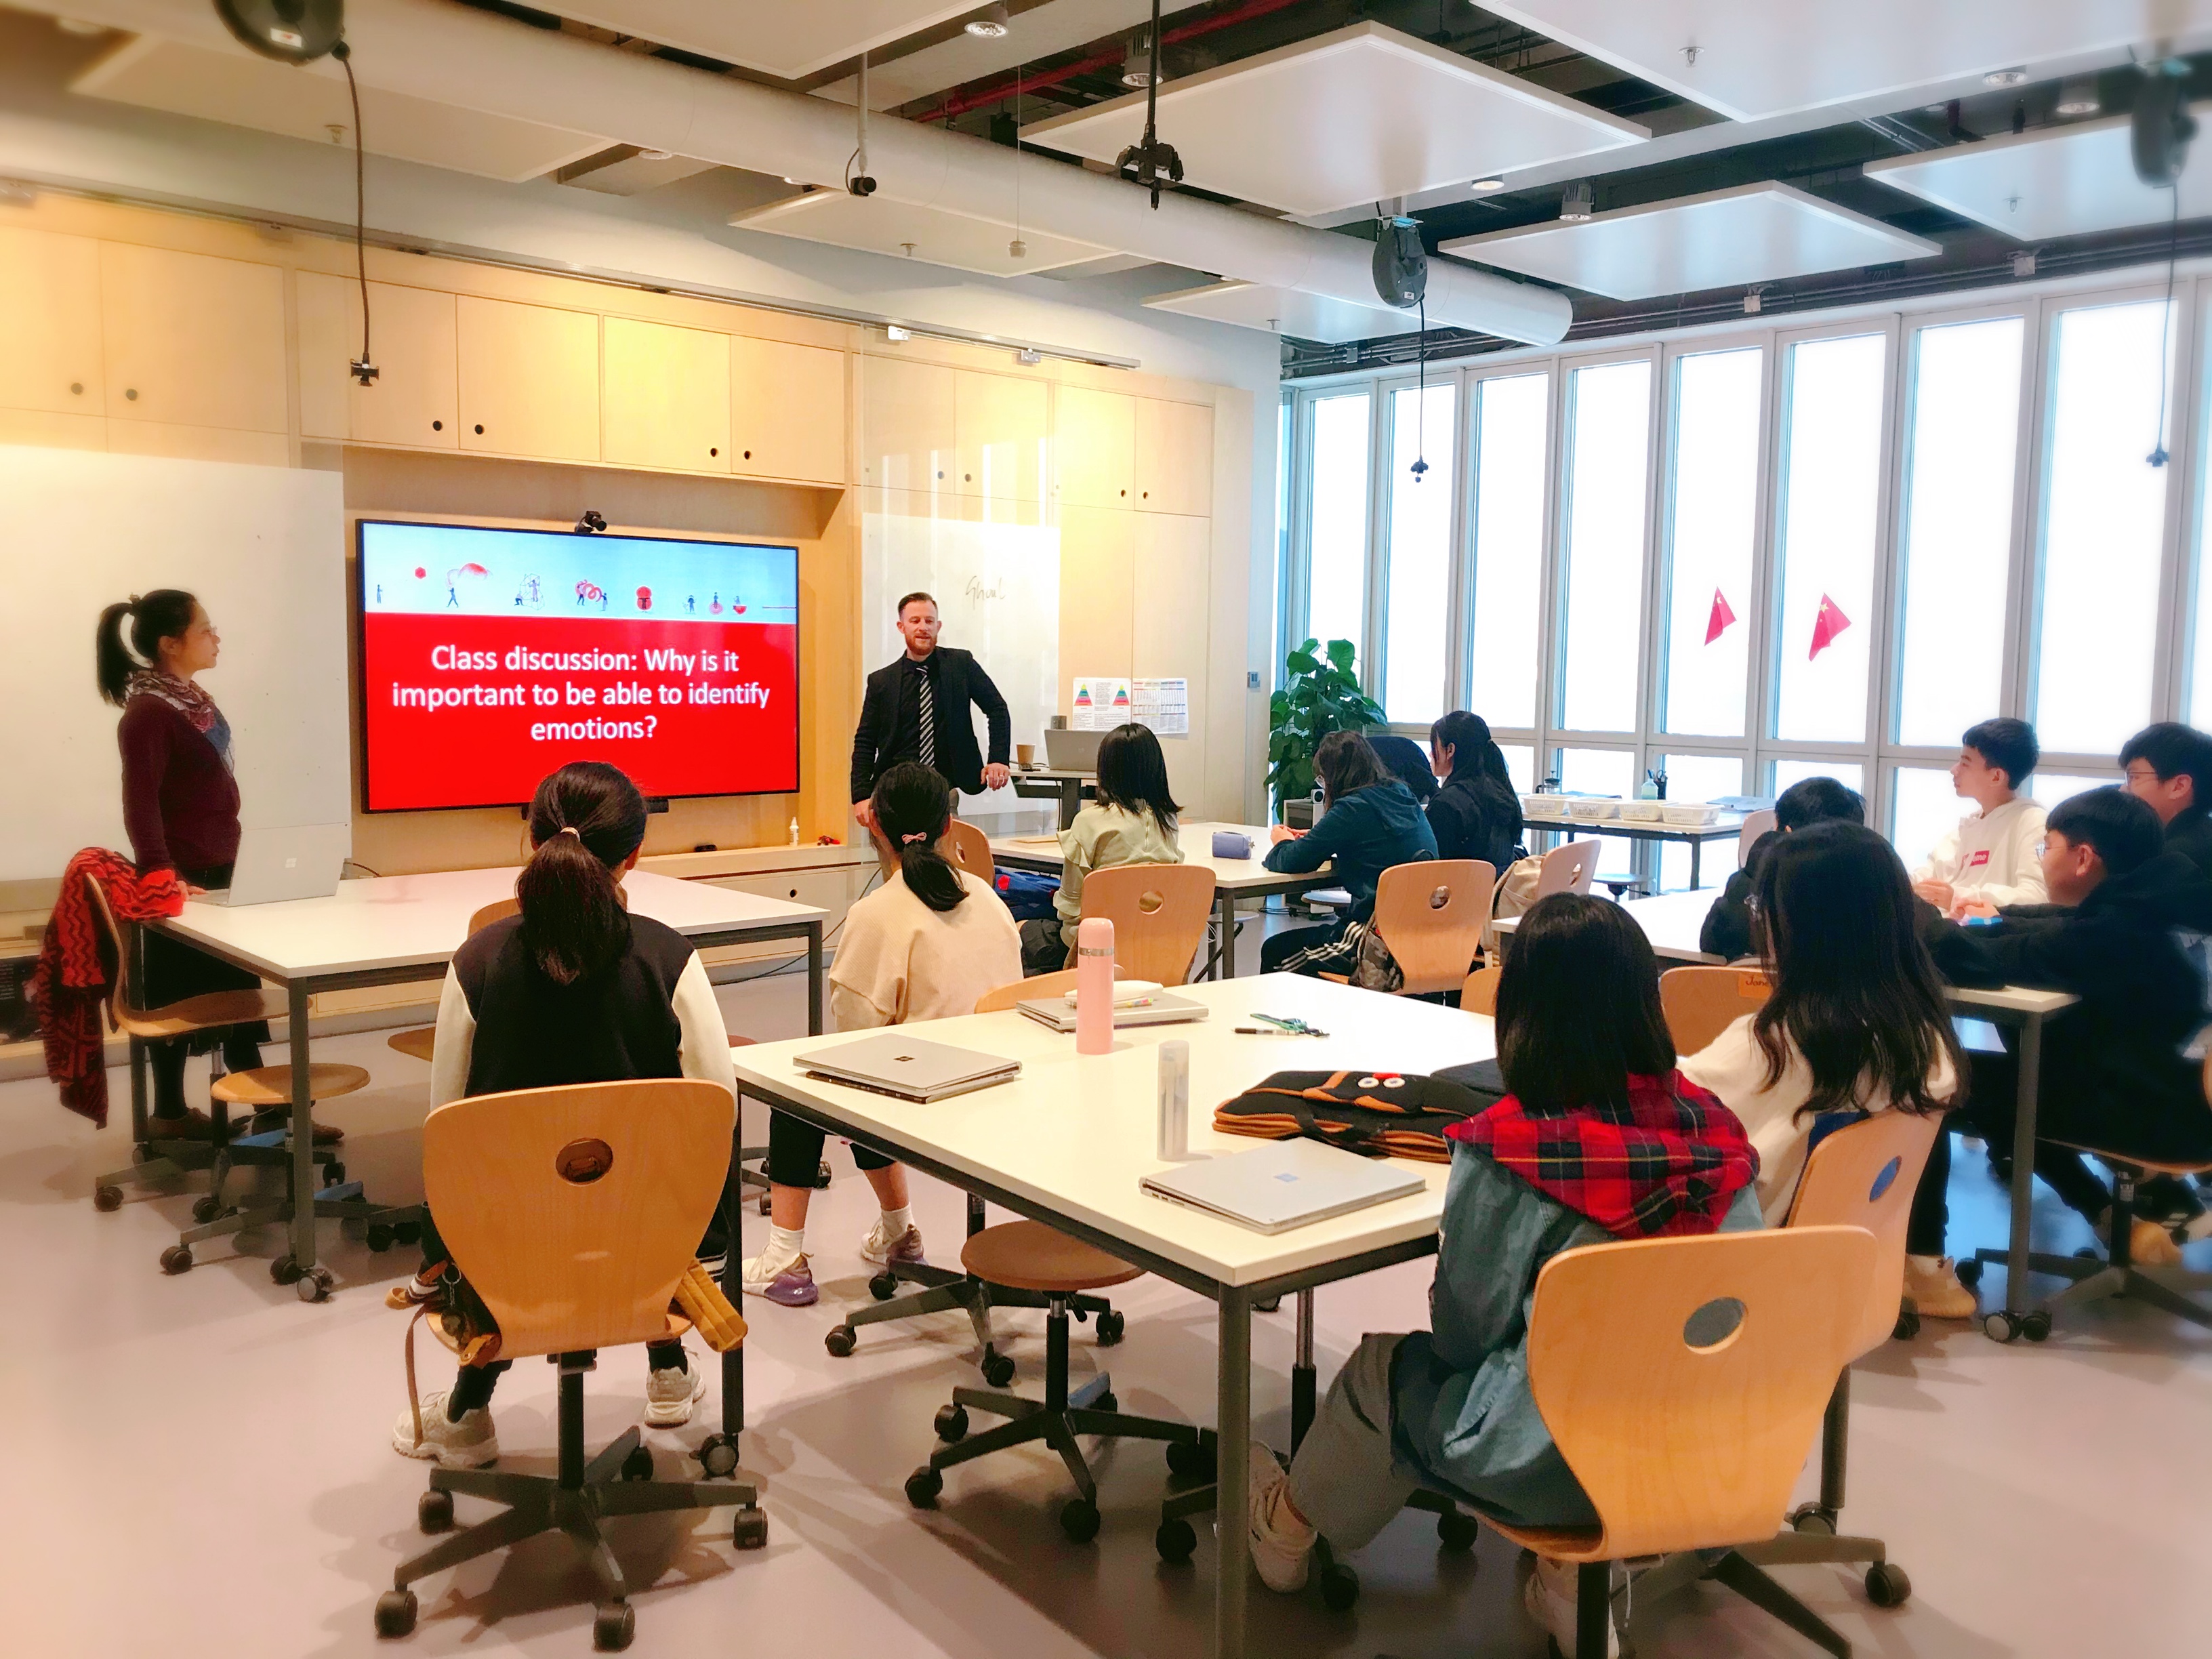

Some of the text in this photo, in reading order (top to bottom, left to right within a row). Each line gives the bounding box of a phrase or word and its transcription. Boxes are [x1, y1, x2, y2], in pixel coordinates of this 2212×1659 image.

[431, 644, 739, 677] Class discussion: Why is it
[392, 681, 771, 712] important to be able to identify
[531, 715, 657, 741] emotions?
